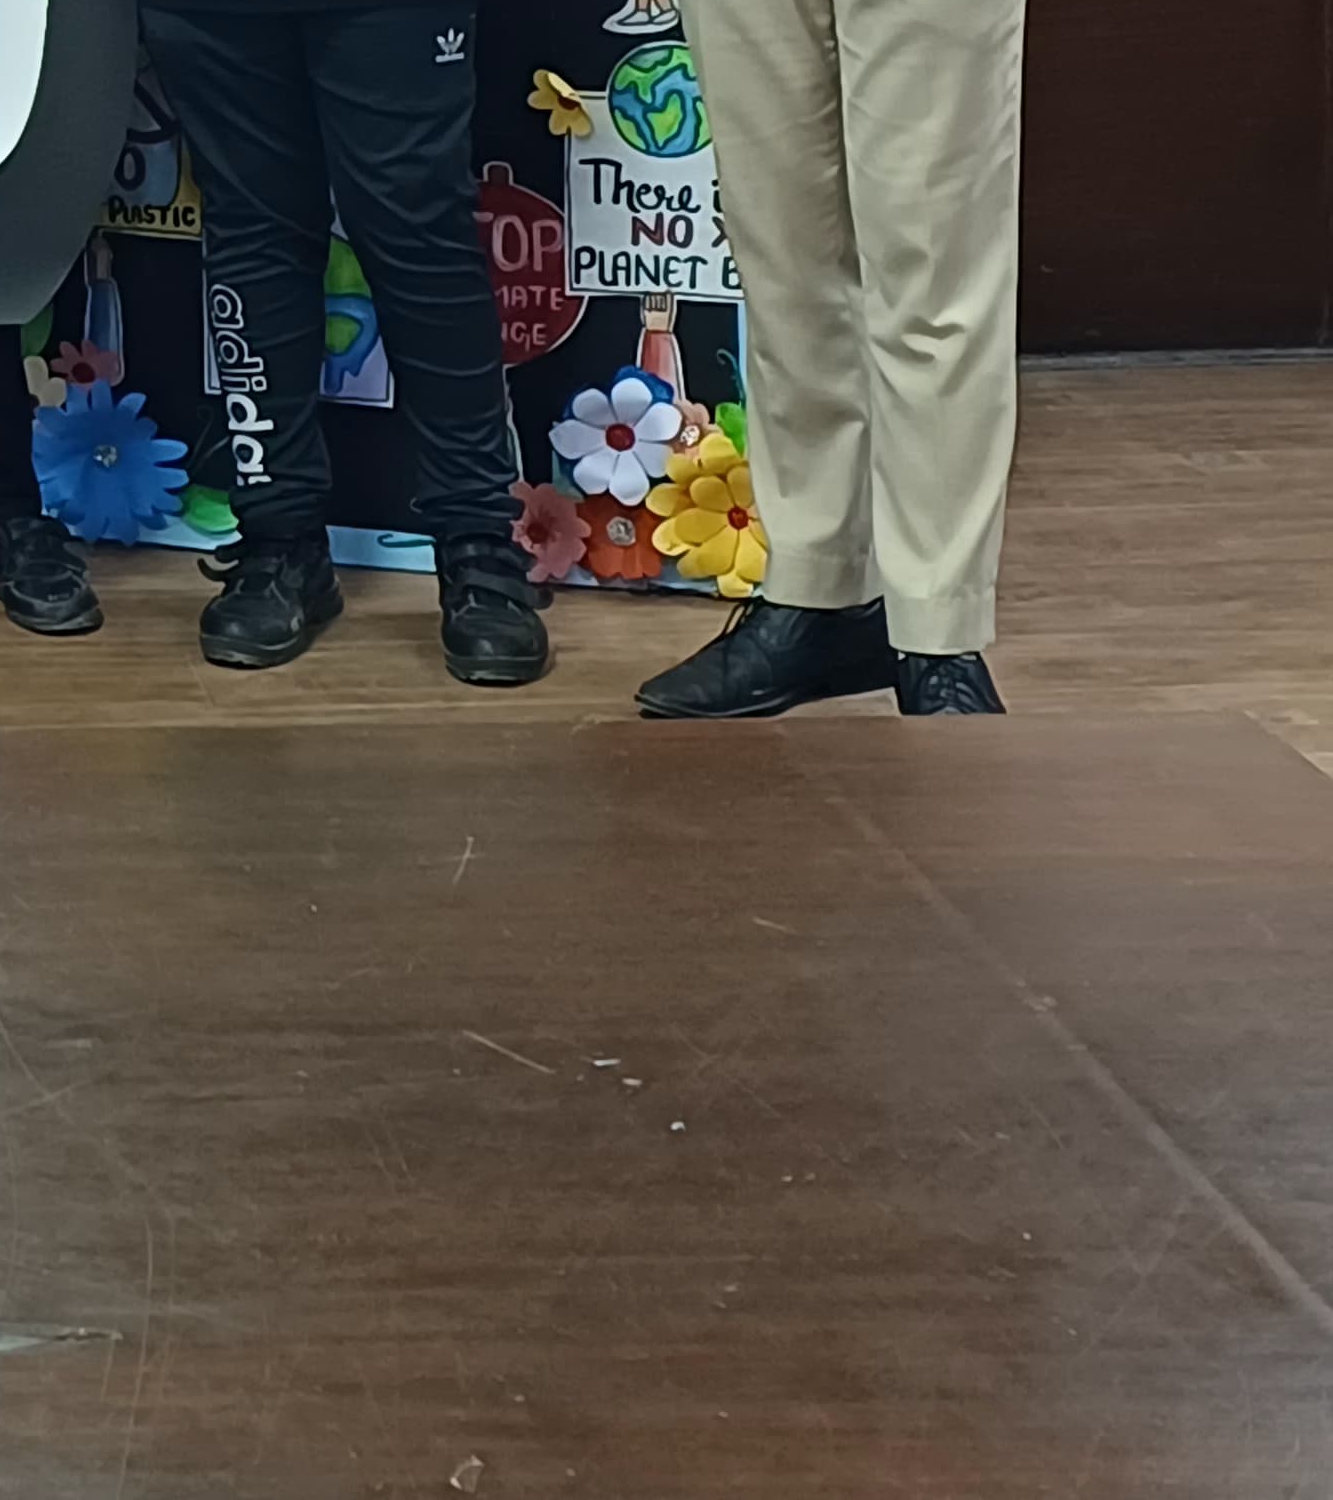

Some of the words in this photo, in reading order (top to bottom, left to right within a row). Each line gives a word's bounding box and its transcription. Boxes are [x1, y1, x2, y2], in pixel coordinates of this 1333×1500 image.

[578, 158, 701, 214] There
[631, 212, 694, 248] NO
[574, 246, 708, 290] PLANET
